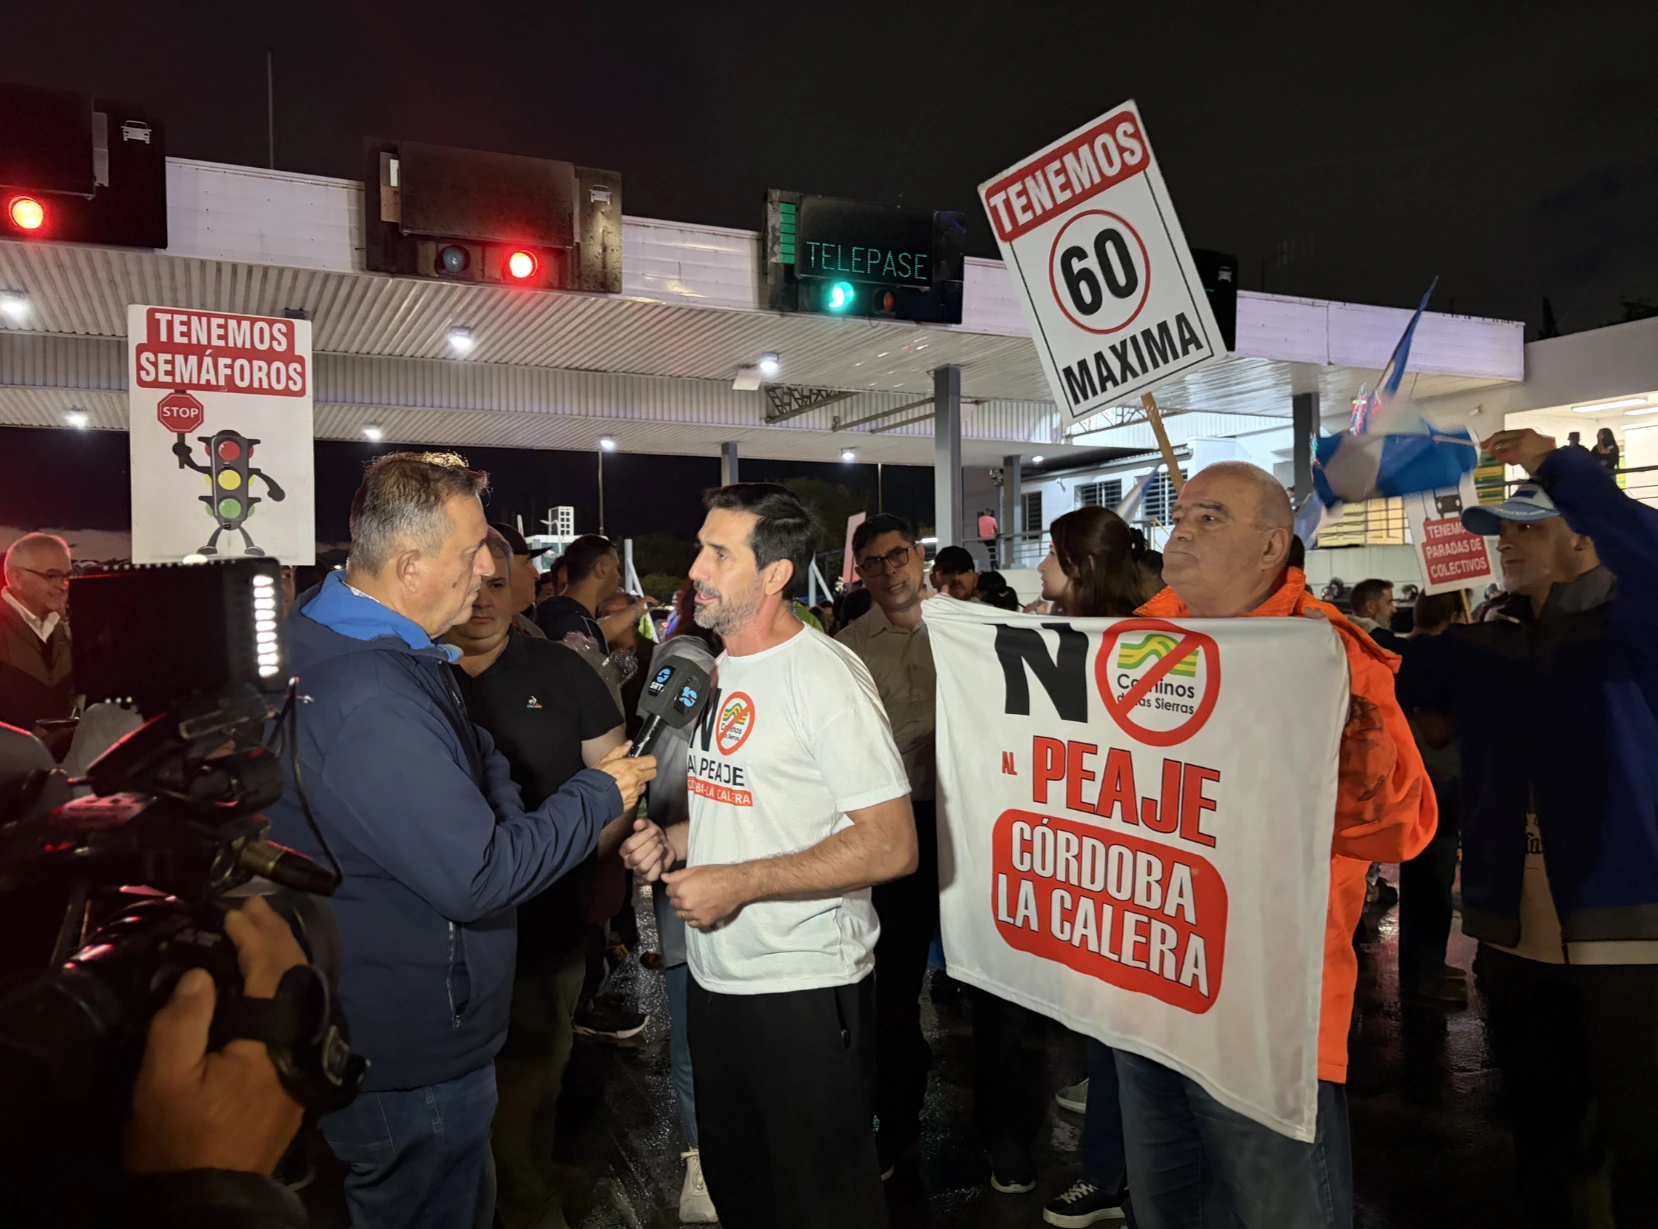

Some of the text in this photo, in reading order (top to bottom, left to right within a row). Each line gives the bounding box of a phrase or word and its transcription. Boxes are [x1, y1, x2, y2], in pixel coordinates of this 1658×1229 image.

[988, 120, 1143, 234] TENEMOS
[806, 241, 928, 280] TELEPASE
[1060, 228, 1138, 316] 60
[154, 312, 288, 352] TENEMOS
[139, 349, 302, 392] SEMÁFOROS
[1062, 312, 1204, 406] MAXIMA
[162, 406, 199, 418] STOP
[1426, 538, 1482, 559] PARADAS DE
[1427, 521, 1466, 538] TENEM
[1430, 557, 1487, 578] COLECTIVOS
[1154, 697, 1194, 715] Sierras
[699, 757, 745, 787] PEAJE
[1002, 735, 1221, 849] AL PEAJE
[1011, 816, 1197, 927] CÓRDOBA
[997, 872, 1210, 999] LA CALERA
